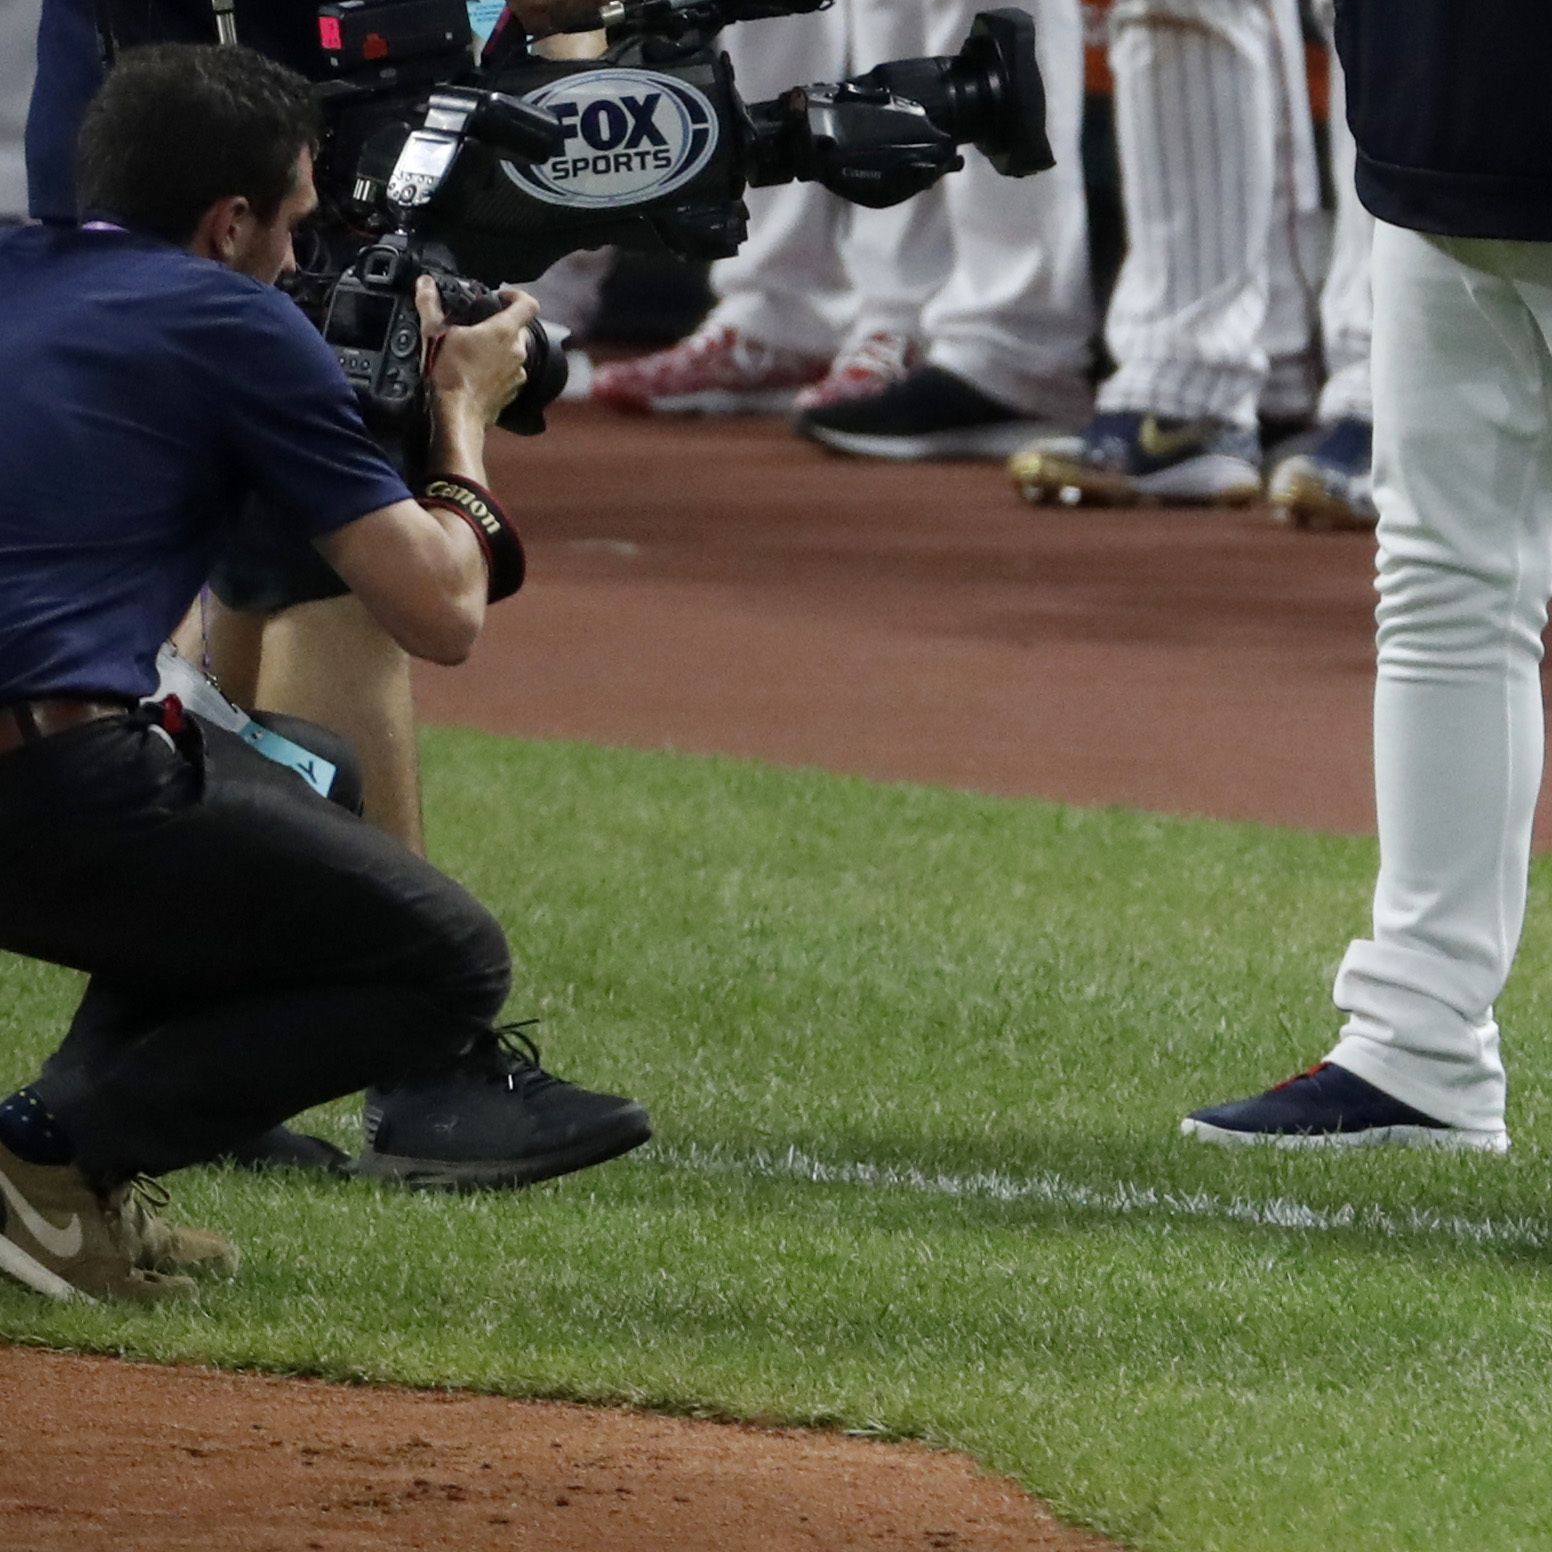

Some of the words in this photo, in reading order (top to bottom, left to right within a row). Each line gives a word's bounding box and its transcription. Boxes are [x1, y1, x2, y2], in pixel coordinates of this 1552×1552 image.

[546, 92, 669, 159] FOX
[551, 148, 673, 181] SPORTS
[425, 480, 501, 535] Canon
